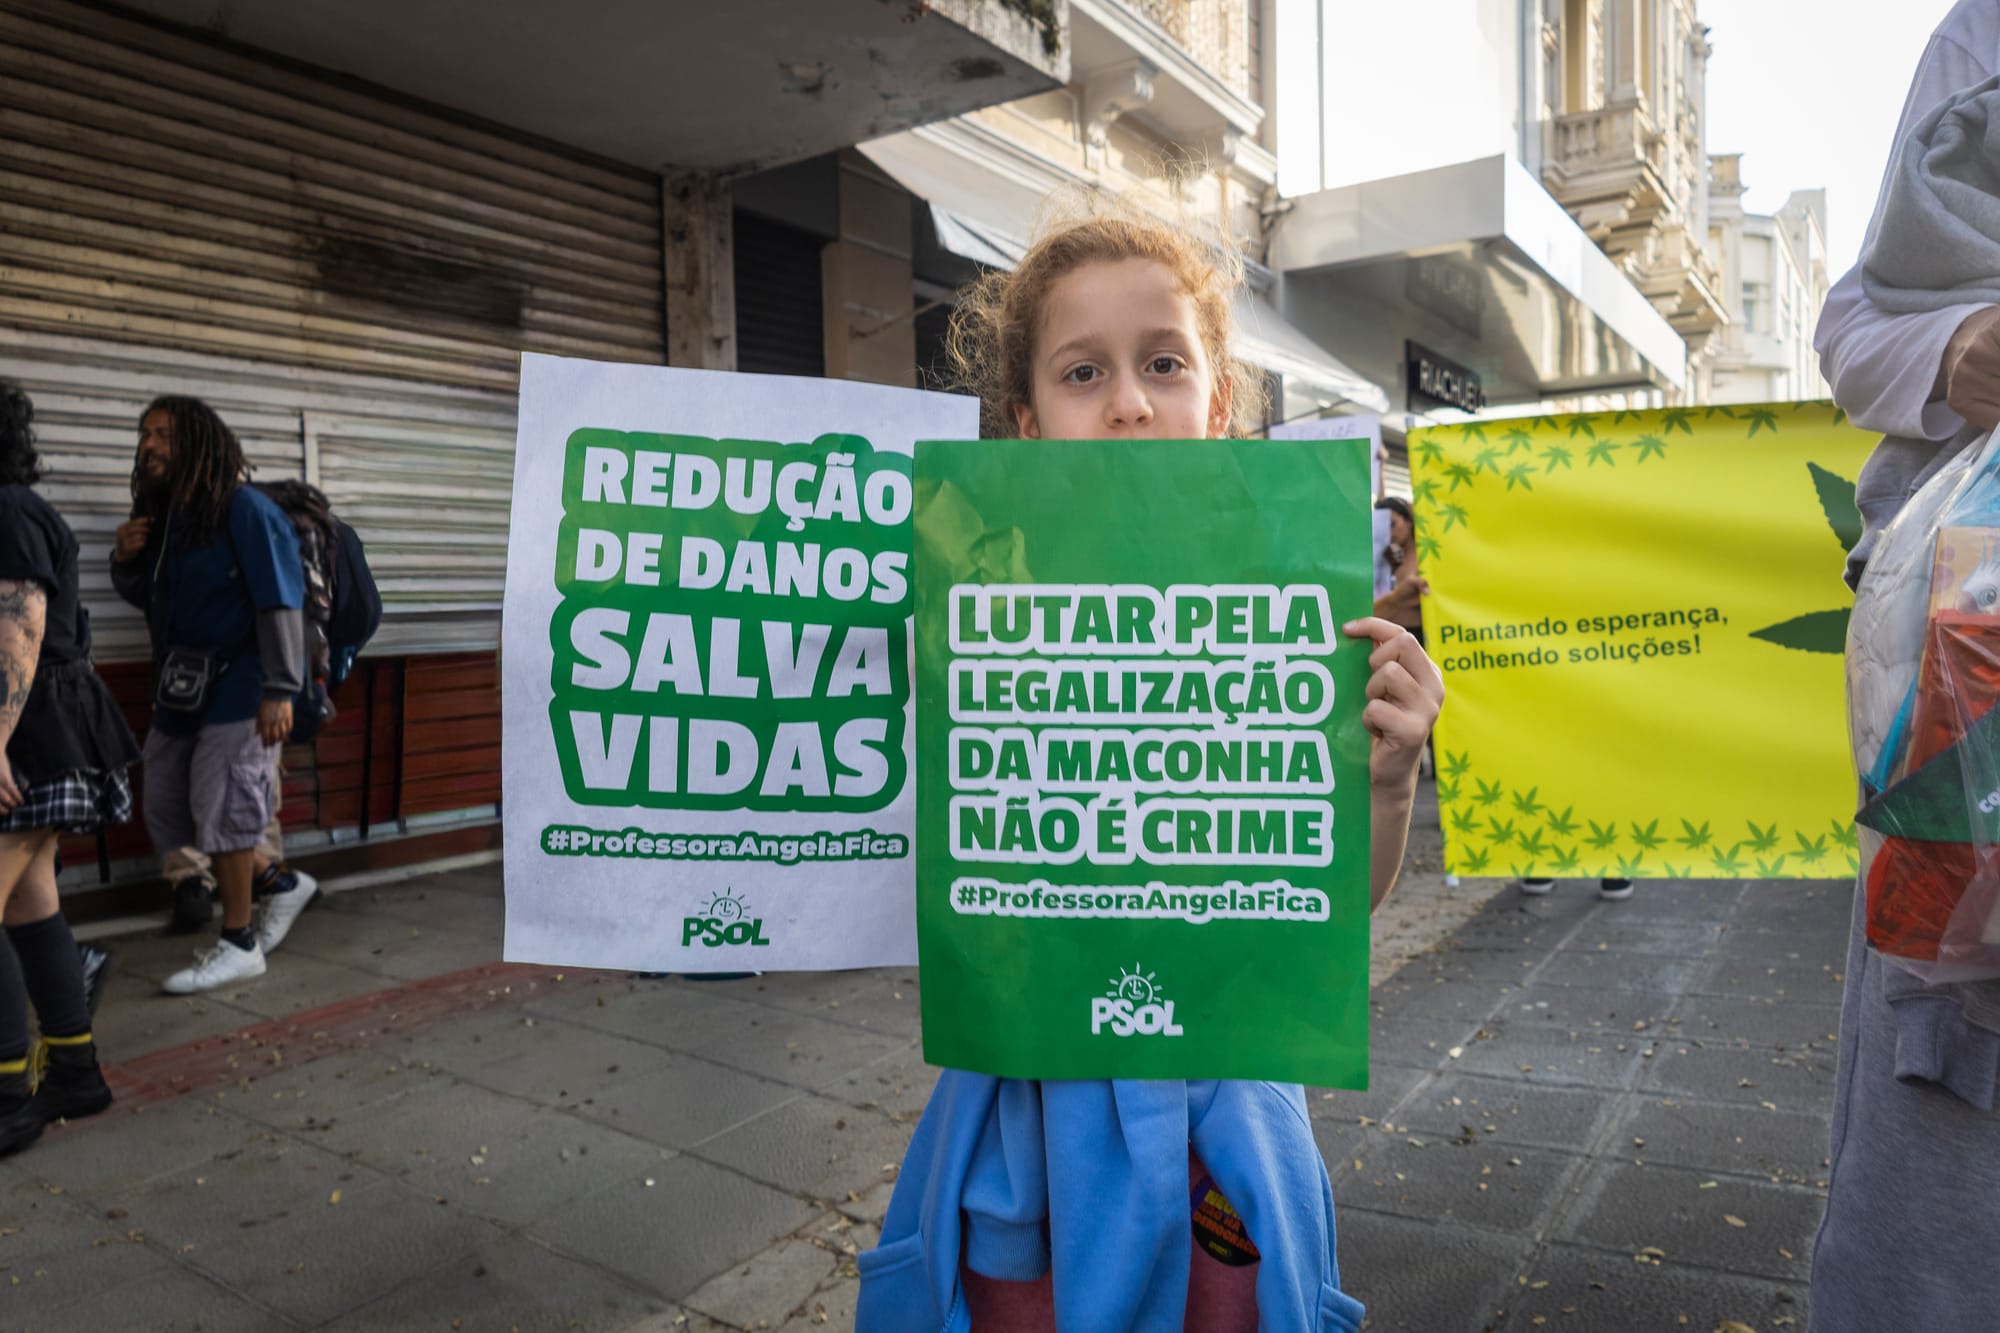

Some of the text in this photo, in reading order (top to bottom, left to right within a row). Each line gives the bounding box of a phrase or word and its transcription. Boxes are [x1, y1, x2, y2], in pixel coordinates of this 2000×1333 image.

[582, 447, 912, 531] REDUÇÃO
[575, 528, 908, 603] DE DANOS
[958, 596, 1325, 645] LUTAR PELA
[1441, 607, 1729, 644] Plantando esperança,
[569, 608, 893, 699] SALVA
[1443, 634, 1701, 672] colhendo soluções!
[958, 660, 1324, 723] LEGALIZAÇÃO
[569, 711, 889, 798] VIDAS
[958, 739, 1324, 783] DA MACONHA
[548, 831, 903, 861] #ProfessoraAngelaFica
[959, 797, 1323, 856] NÃO É CRIME
[957, 885, 1322, 915] #ProfessoraAngelaFica
[682, 917, 770, 948] PSOL
[1091, 997, 1184, 1037] PSOL
